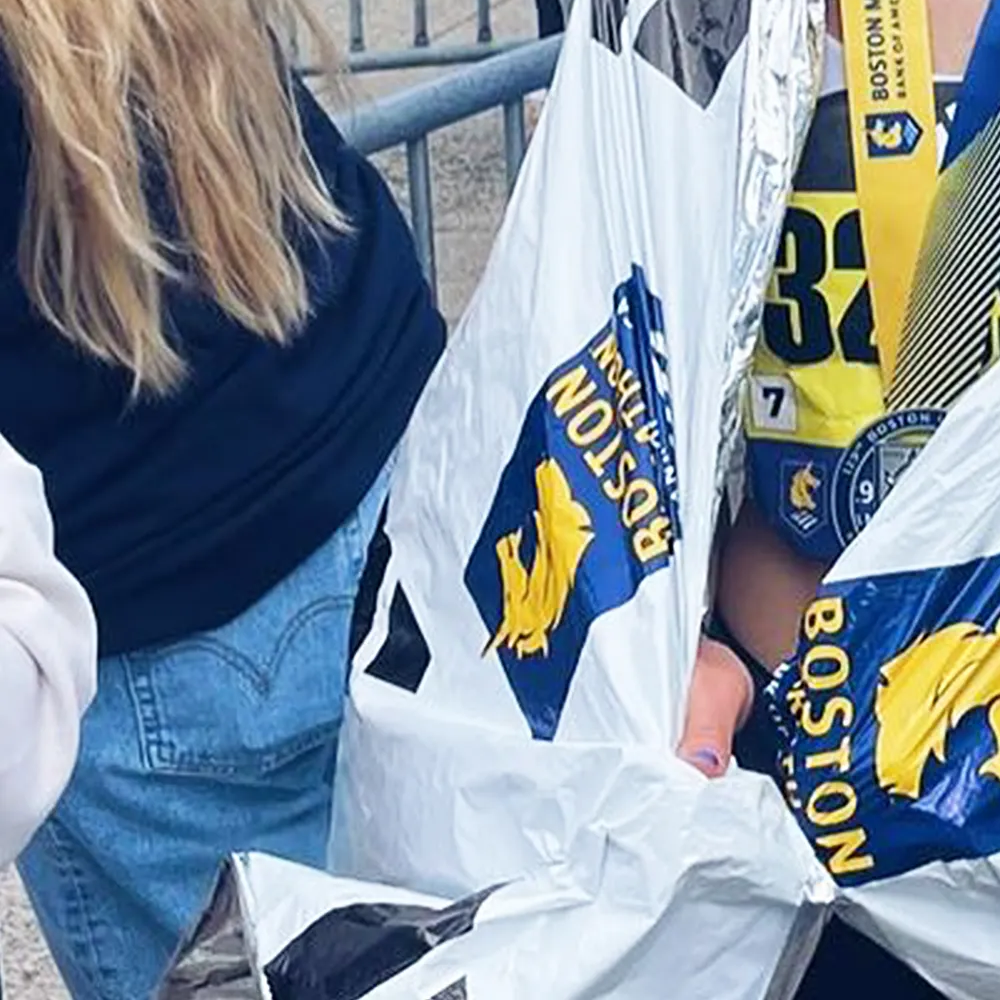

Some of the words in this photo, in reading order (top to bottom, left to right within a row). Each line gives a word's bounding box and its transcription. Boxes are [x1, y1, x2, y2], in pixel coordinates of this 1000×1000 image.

[866, 16, 889, 102] BOSTON
[892, 35, 903, 54] OF
[895, 57, 906, 98] BANK
[762, 387, 785, 418] 7
[867, 412, 931, 443] BOSTON
[546, 365, 671, 563] BOSTON
[801, 596, 875, 875] BOSTON
